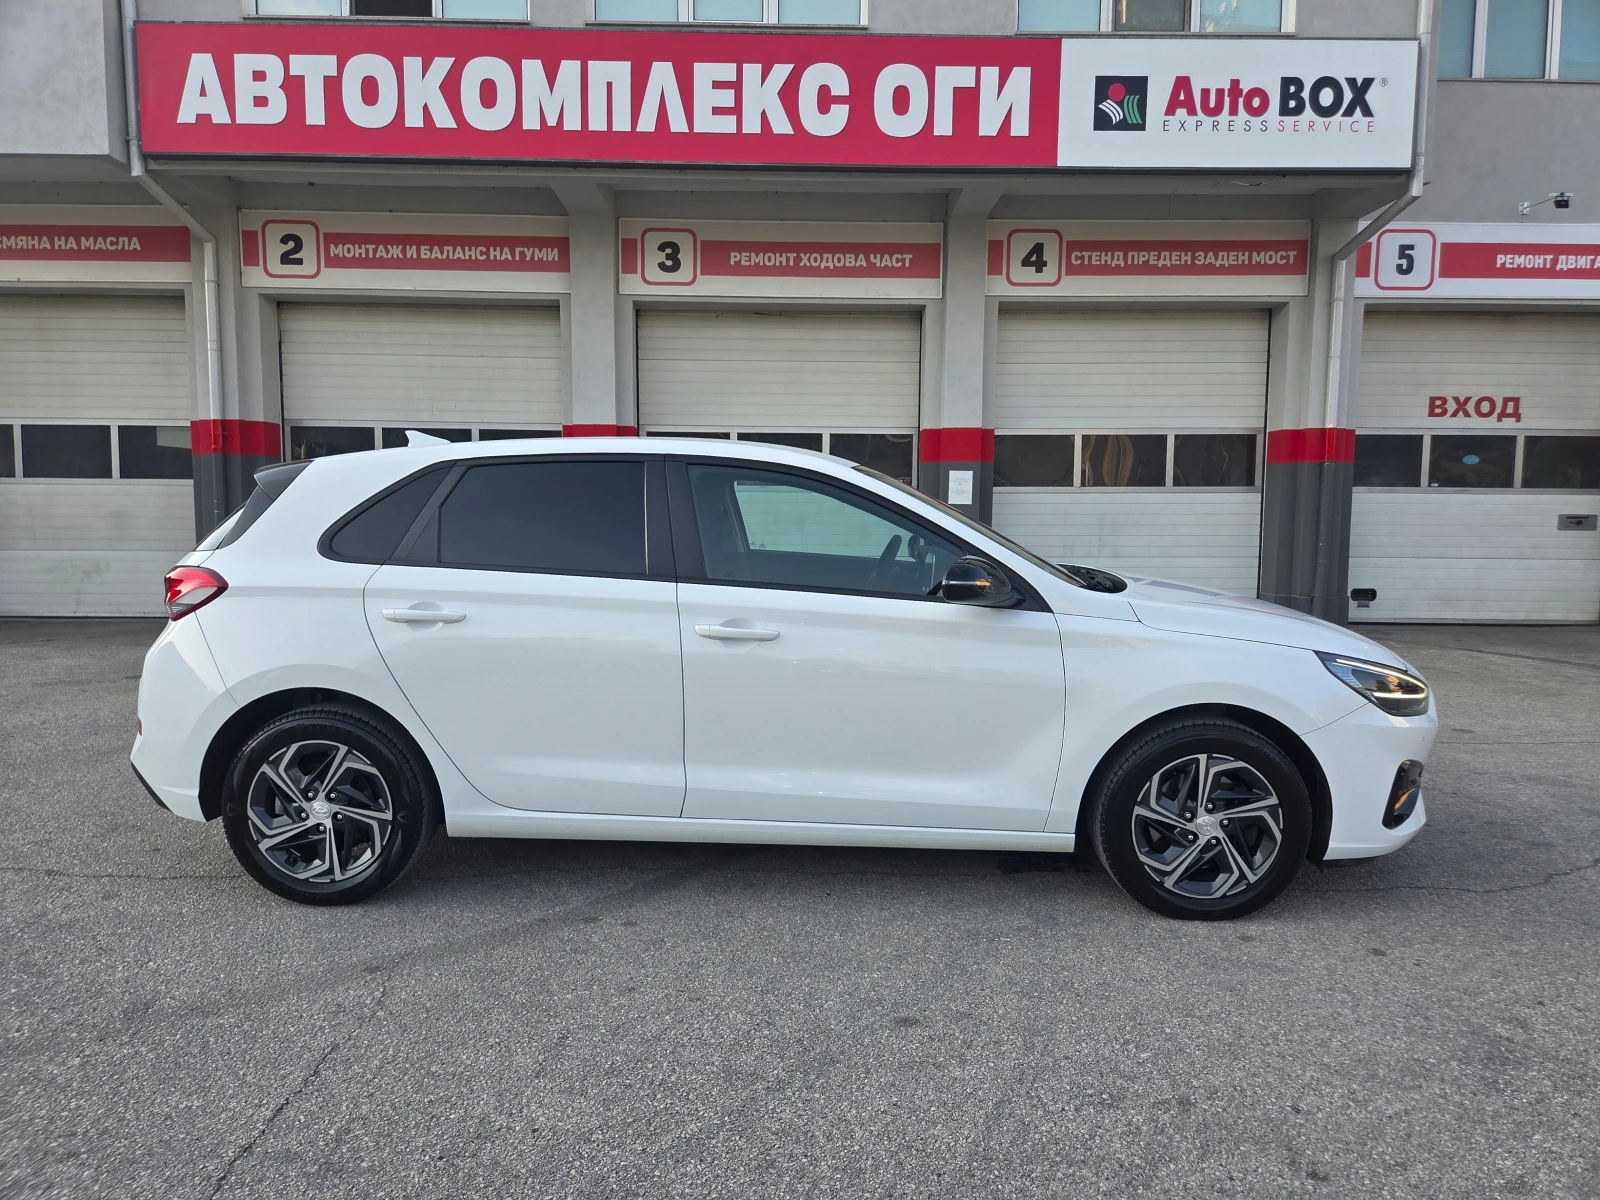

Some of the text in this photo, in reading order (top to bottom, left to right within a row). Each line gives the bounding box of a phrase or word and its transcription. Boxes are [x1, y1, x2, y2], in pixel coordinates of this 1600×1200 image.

[176, 52, 1032, 139] АВТОКОМПЛЕКС ОГИ
[1163, 75, 1271, 118] Auto
[0, 236, 142, 251] МЯНА НА МАСЛА
[279, 233, 304, 266] 2
[329, 243, 559, 262] МОНТАЖ И БАЛАНС НА ГУМИ
[656, 240, 682, 274] 3
[1020, 242, 1047, 274] 4
[730, 252, 913, 269] РЕМОНТ ХОДОВА ЧАСТ
[1070, 251, 1297, 268] СТЕНД ПРЕДЕН ЗАДЕН МОСТ
[1395, 244, 1415, 276] 5
[1496, 254, 1554, 269] РЕМОНТ
[1427, 396, 1522, 423] ВХОД
